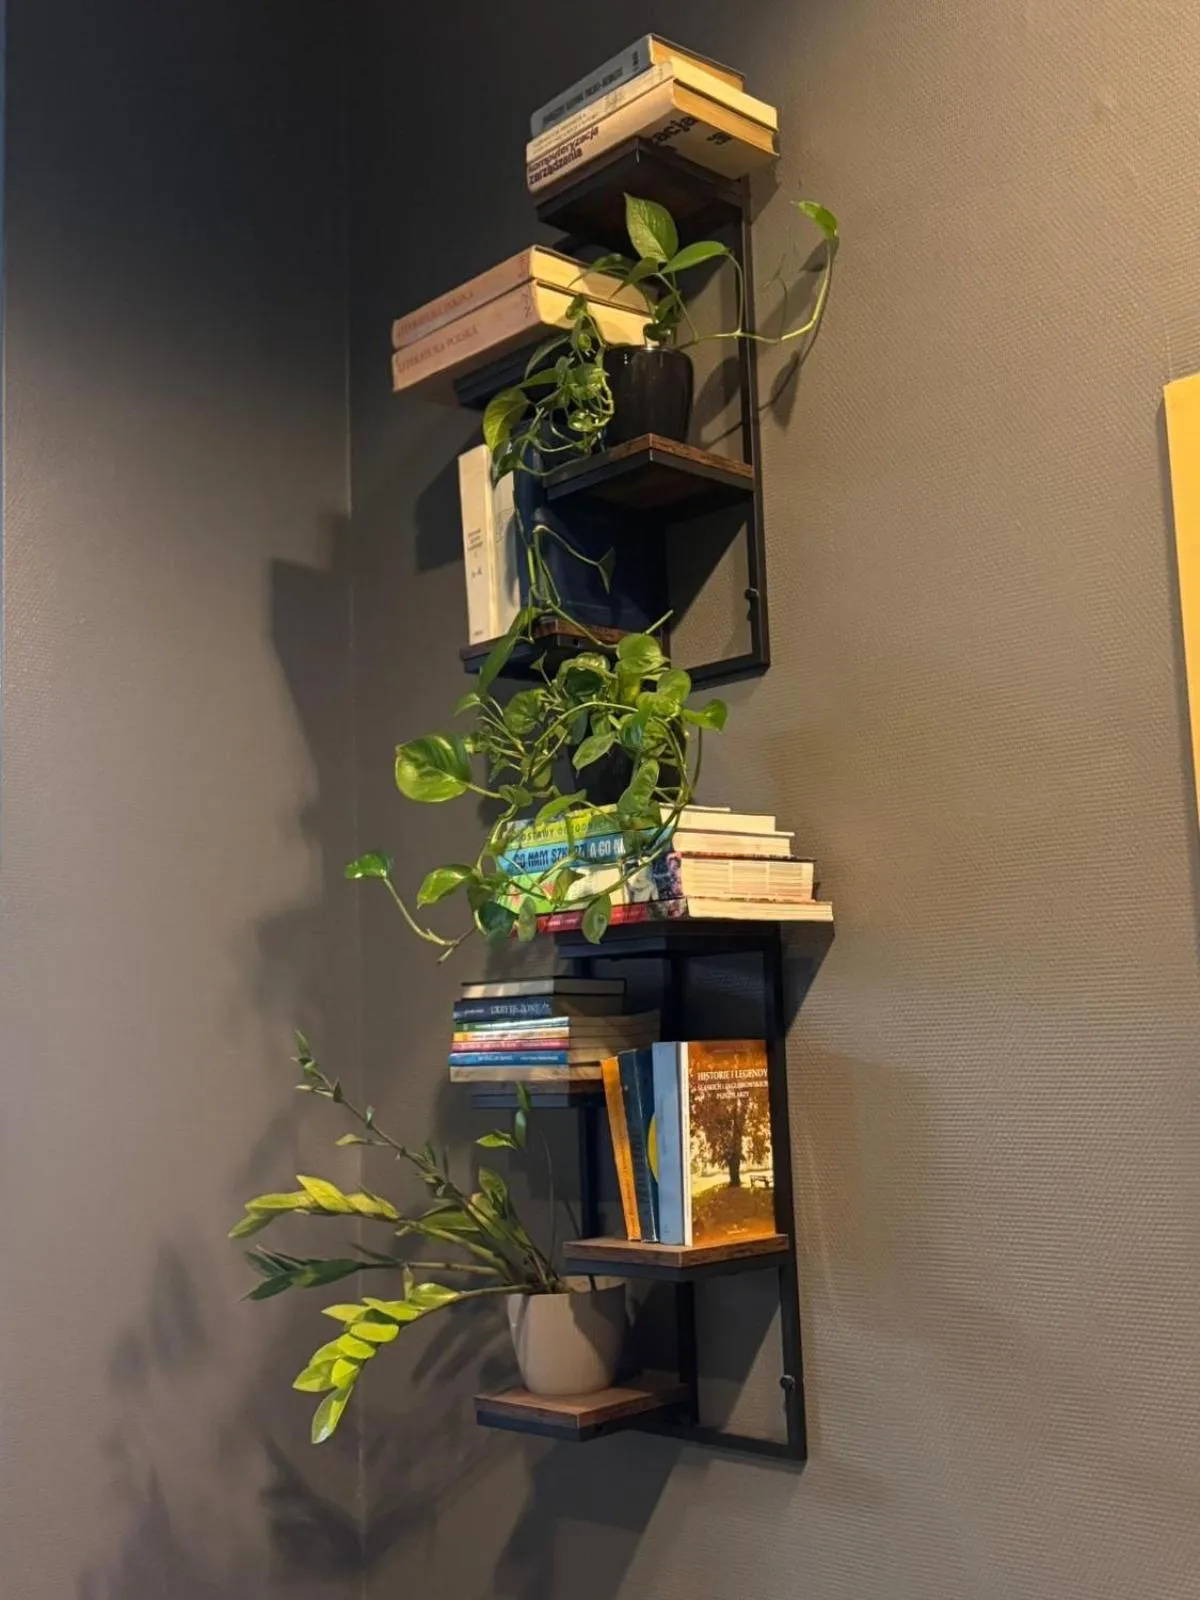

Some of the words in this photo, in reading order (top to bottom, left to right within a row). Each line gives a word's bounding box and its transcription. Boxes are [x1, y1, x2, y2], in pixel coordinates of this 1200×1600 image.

[527, 849, 549, 867] NAM
[599, 840, 611, 856] CO
[697, 1070, 729, 1081] HISTORIE
[735, 1068, 768, 1079] LEGENDY
